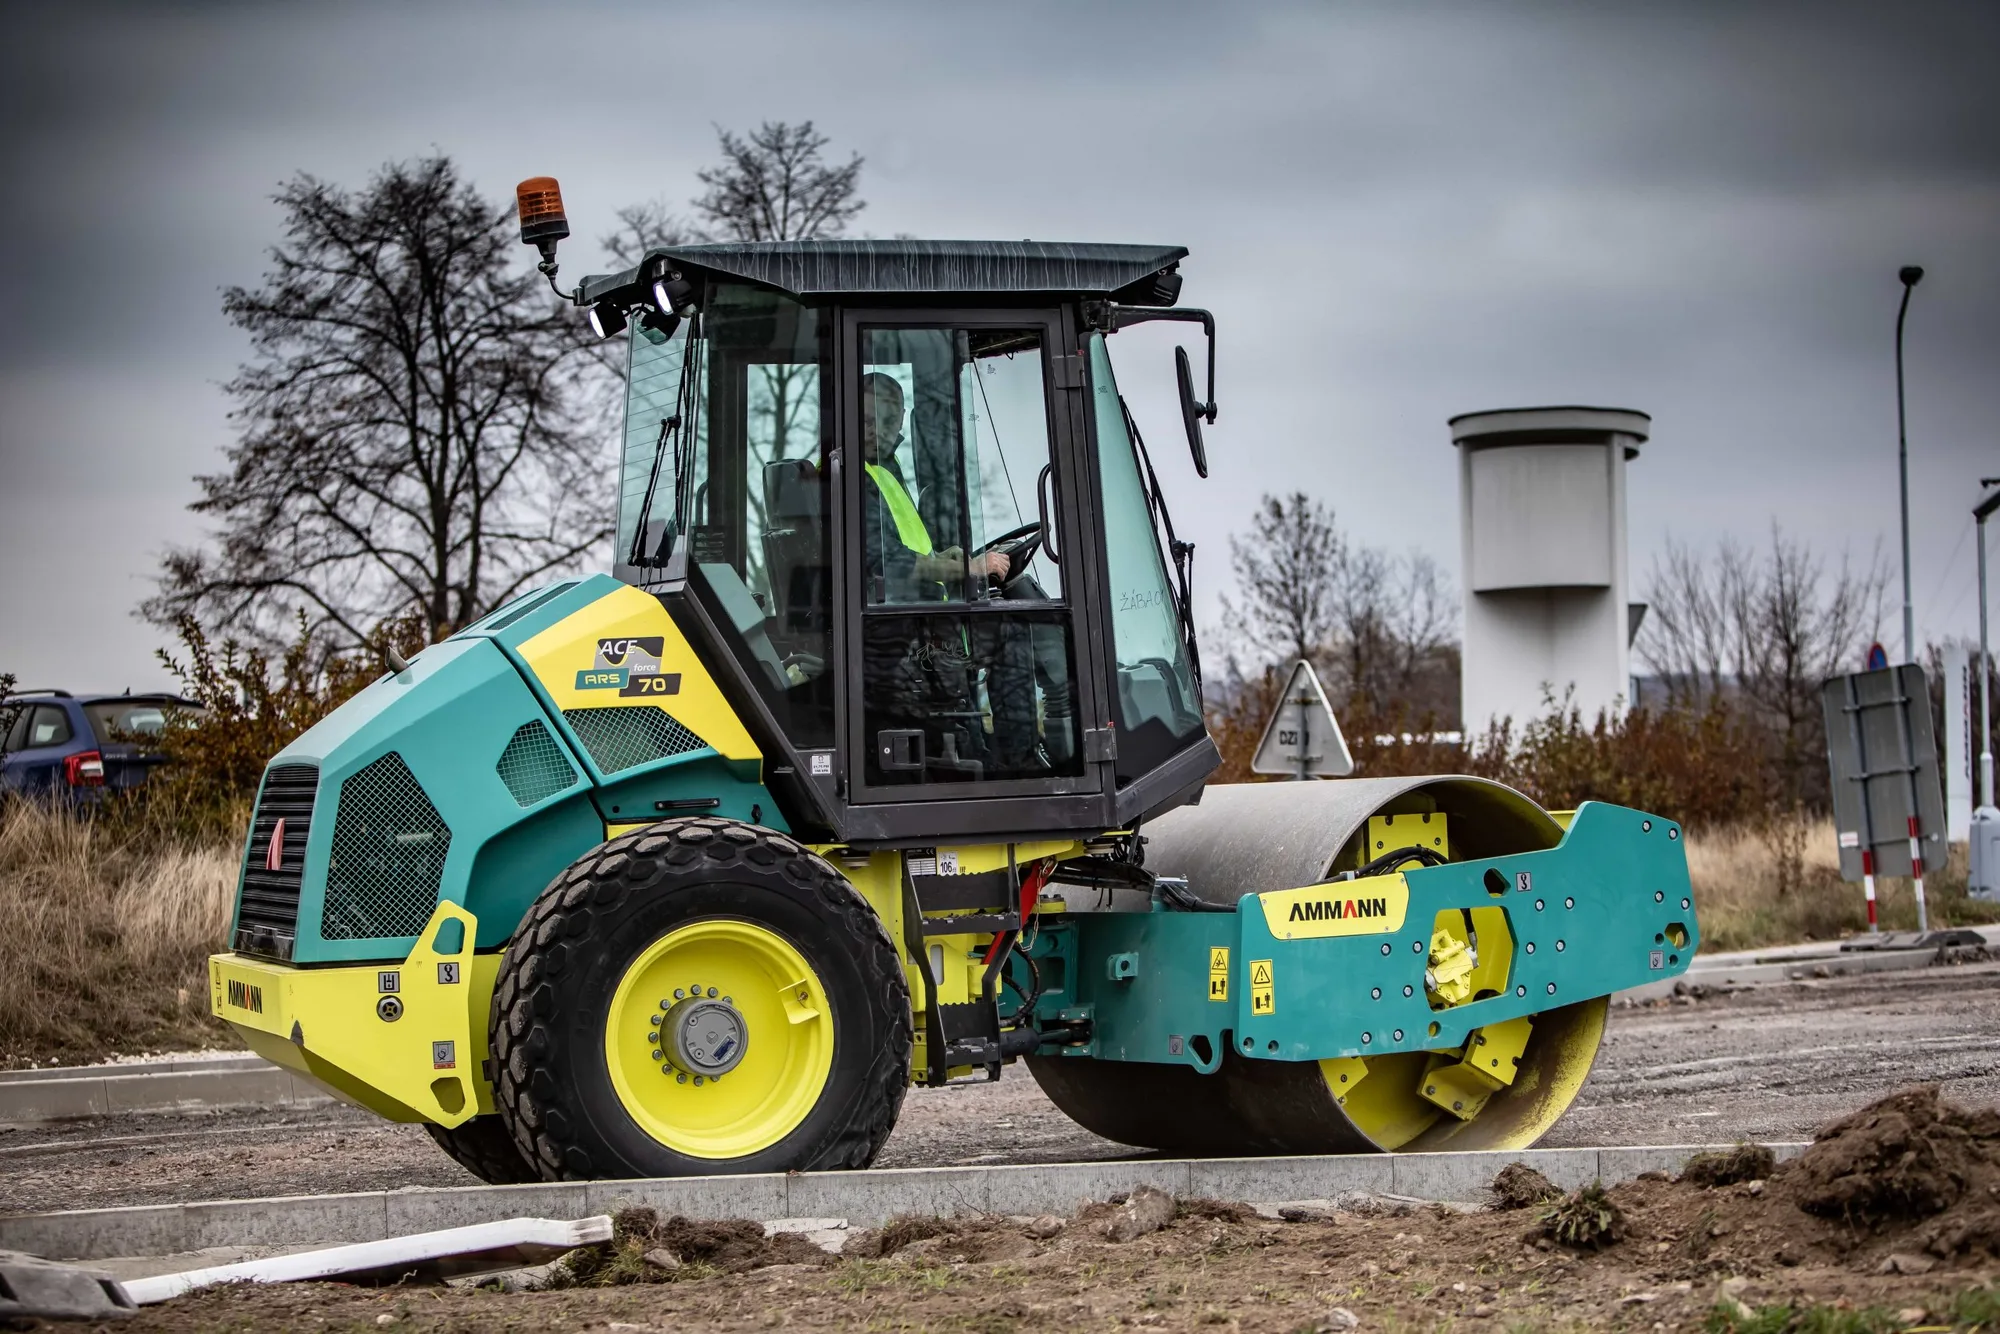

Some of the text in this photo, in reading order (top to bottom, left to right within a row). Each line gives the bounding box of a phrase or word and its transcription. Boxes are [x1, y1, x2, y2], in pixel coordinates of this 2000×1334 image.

[600, 640, 637, 655] ACE
[633, 663, 656, 672] force
[585, 674, 620, 685] ARS
[639, 678, 666, 692] 70
[940, 862, 952, 873] 106
[1289, 898, 1386, 921] AMMANN
[228, 979, 262, 1014] AMMANN
